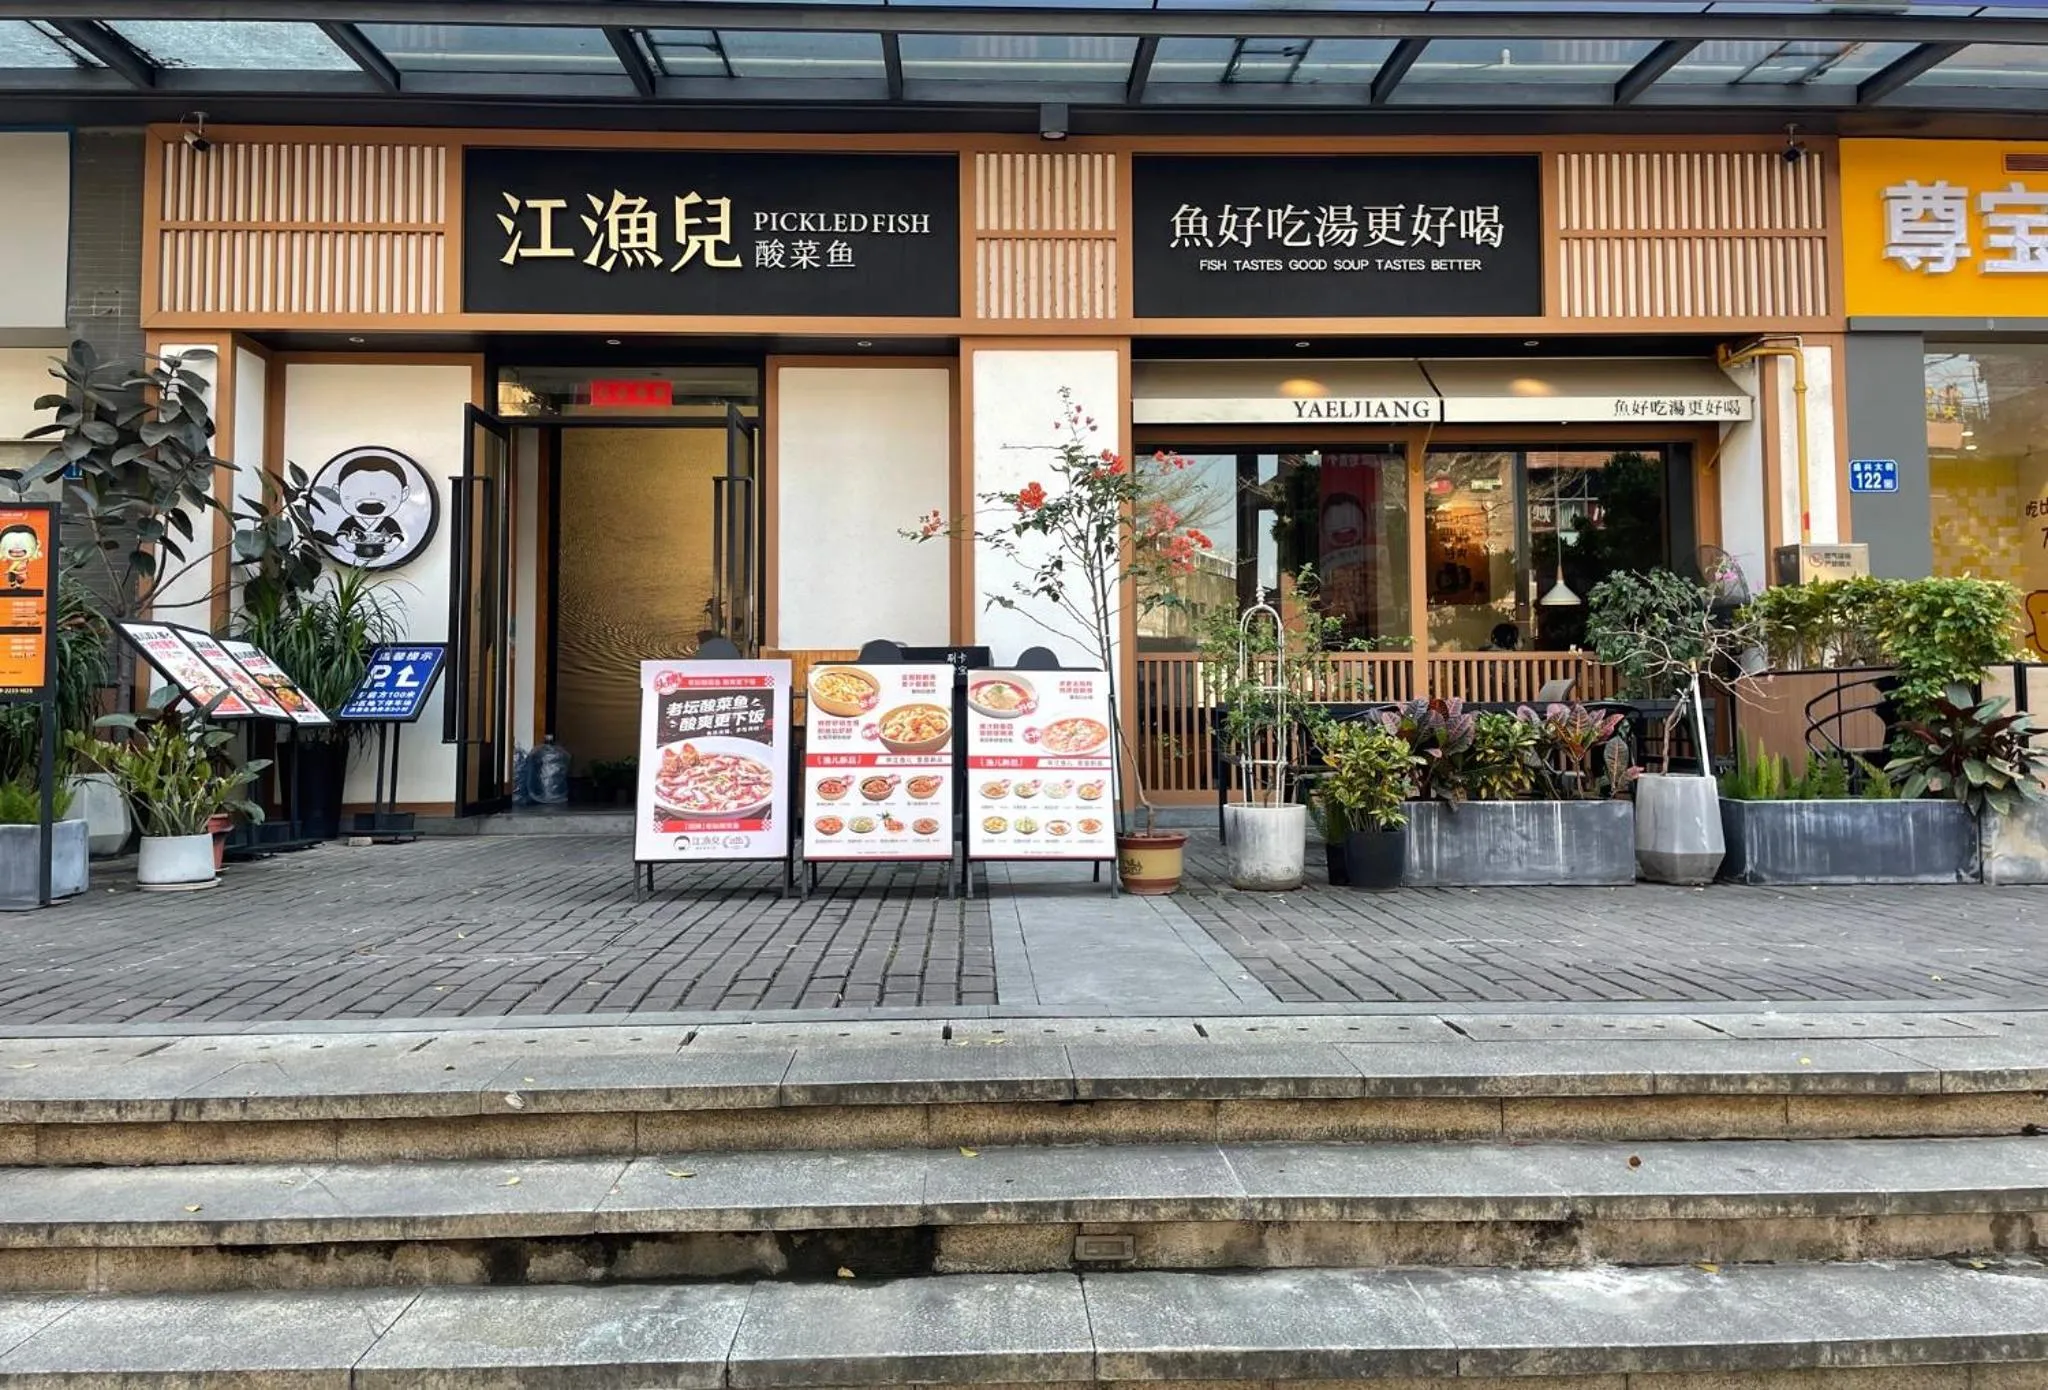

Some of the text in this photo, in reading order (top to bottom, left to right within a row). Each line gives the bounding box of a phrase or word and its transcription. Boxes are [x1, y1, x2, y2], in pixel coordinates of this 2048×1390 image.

[496, 189, 743, 273] 江漁兒
[753, 211, 931, 235] PICKLED FISH
[1169, 203, 1505, 249] 魚好吃湯更好喝
[1881, 180, 2048, 274] 尊宝
[754, 239, 857, 269] 酸菜鱼
[1200, 259, 1482, 271] FISH TASTES GOOD SOUP TASTES BETTER
[1293, 400, 1431, 420] YAELJIANG
[666, 695, 749, 717] 老坛酸菜鱼
[679, 708, 766, 732] 酸爽更下饭
